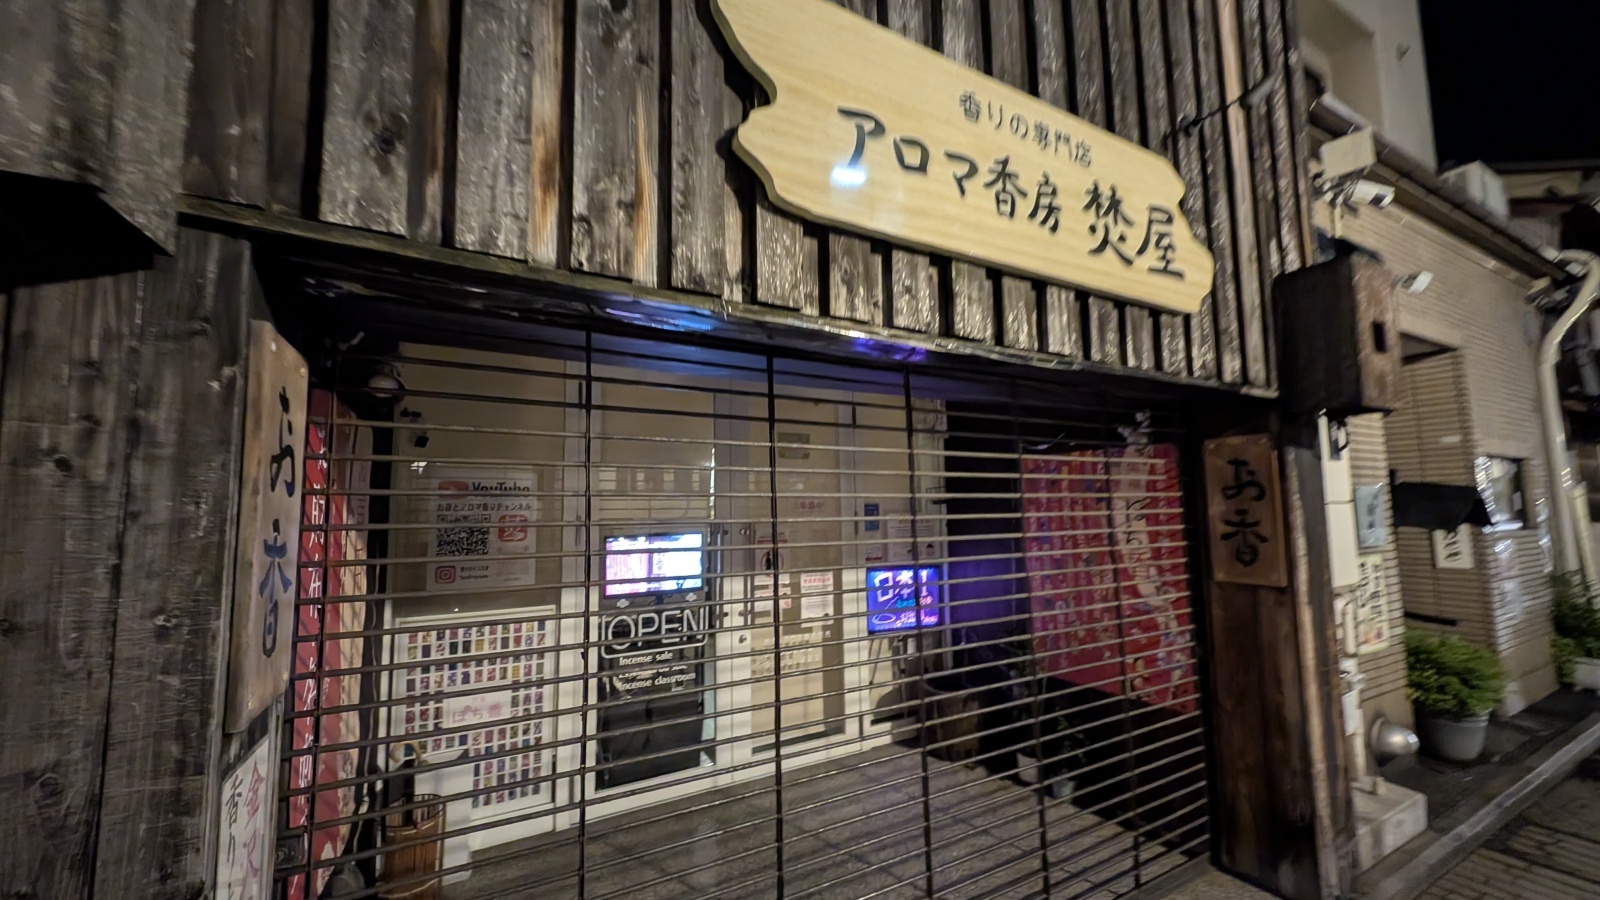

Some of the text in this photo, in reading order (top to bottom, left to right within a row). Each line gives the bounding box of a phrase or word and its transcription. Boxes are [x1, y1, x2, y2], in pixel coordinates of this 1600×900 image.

[959, 89, 1092, 168] 香りの専門店
[1220, 458, 1269, 568] お香
[607, 607, 704, 650] OPEN
[619, 651, 673, 666] Incense sale
[619, 673, 696, 690] Incense classroom
